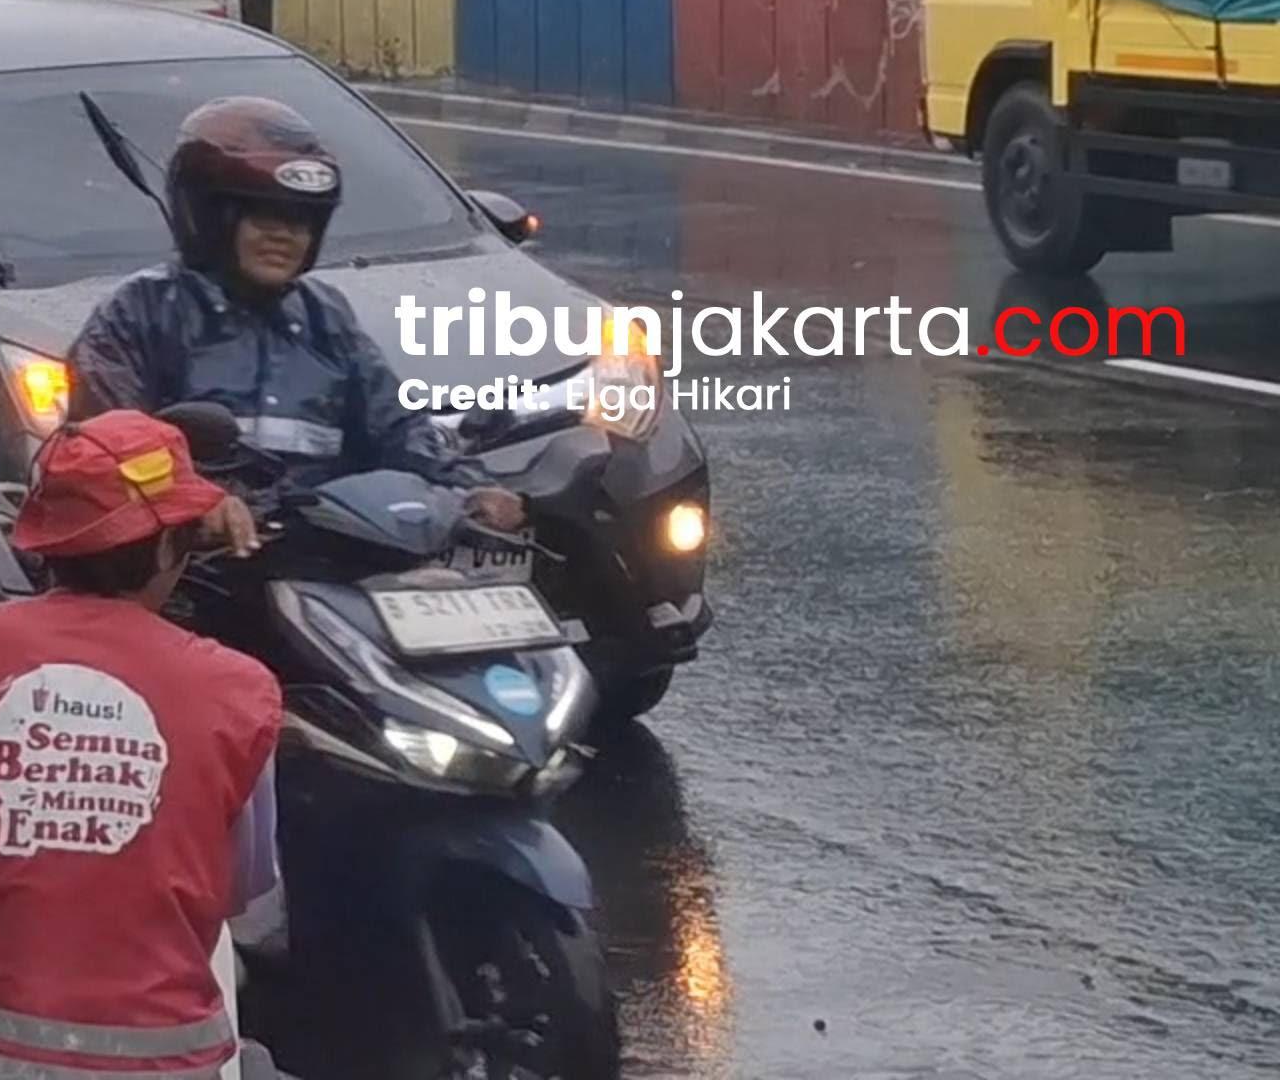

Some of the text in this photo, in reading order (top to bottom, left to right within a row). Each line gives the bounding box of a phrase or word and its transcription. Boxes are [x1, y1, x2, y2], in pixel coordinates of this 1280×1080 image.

[53, 693, 124, 720] haus!
[26, 722, 163, 763] Semua
[41, 790, 145, 818] Minum
[4, 808, 112, 848] Enak
